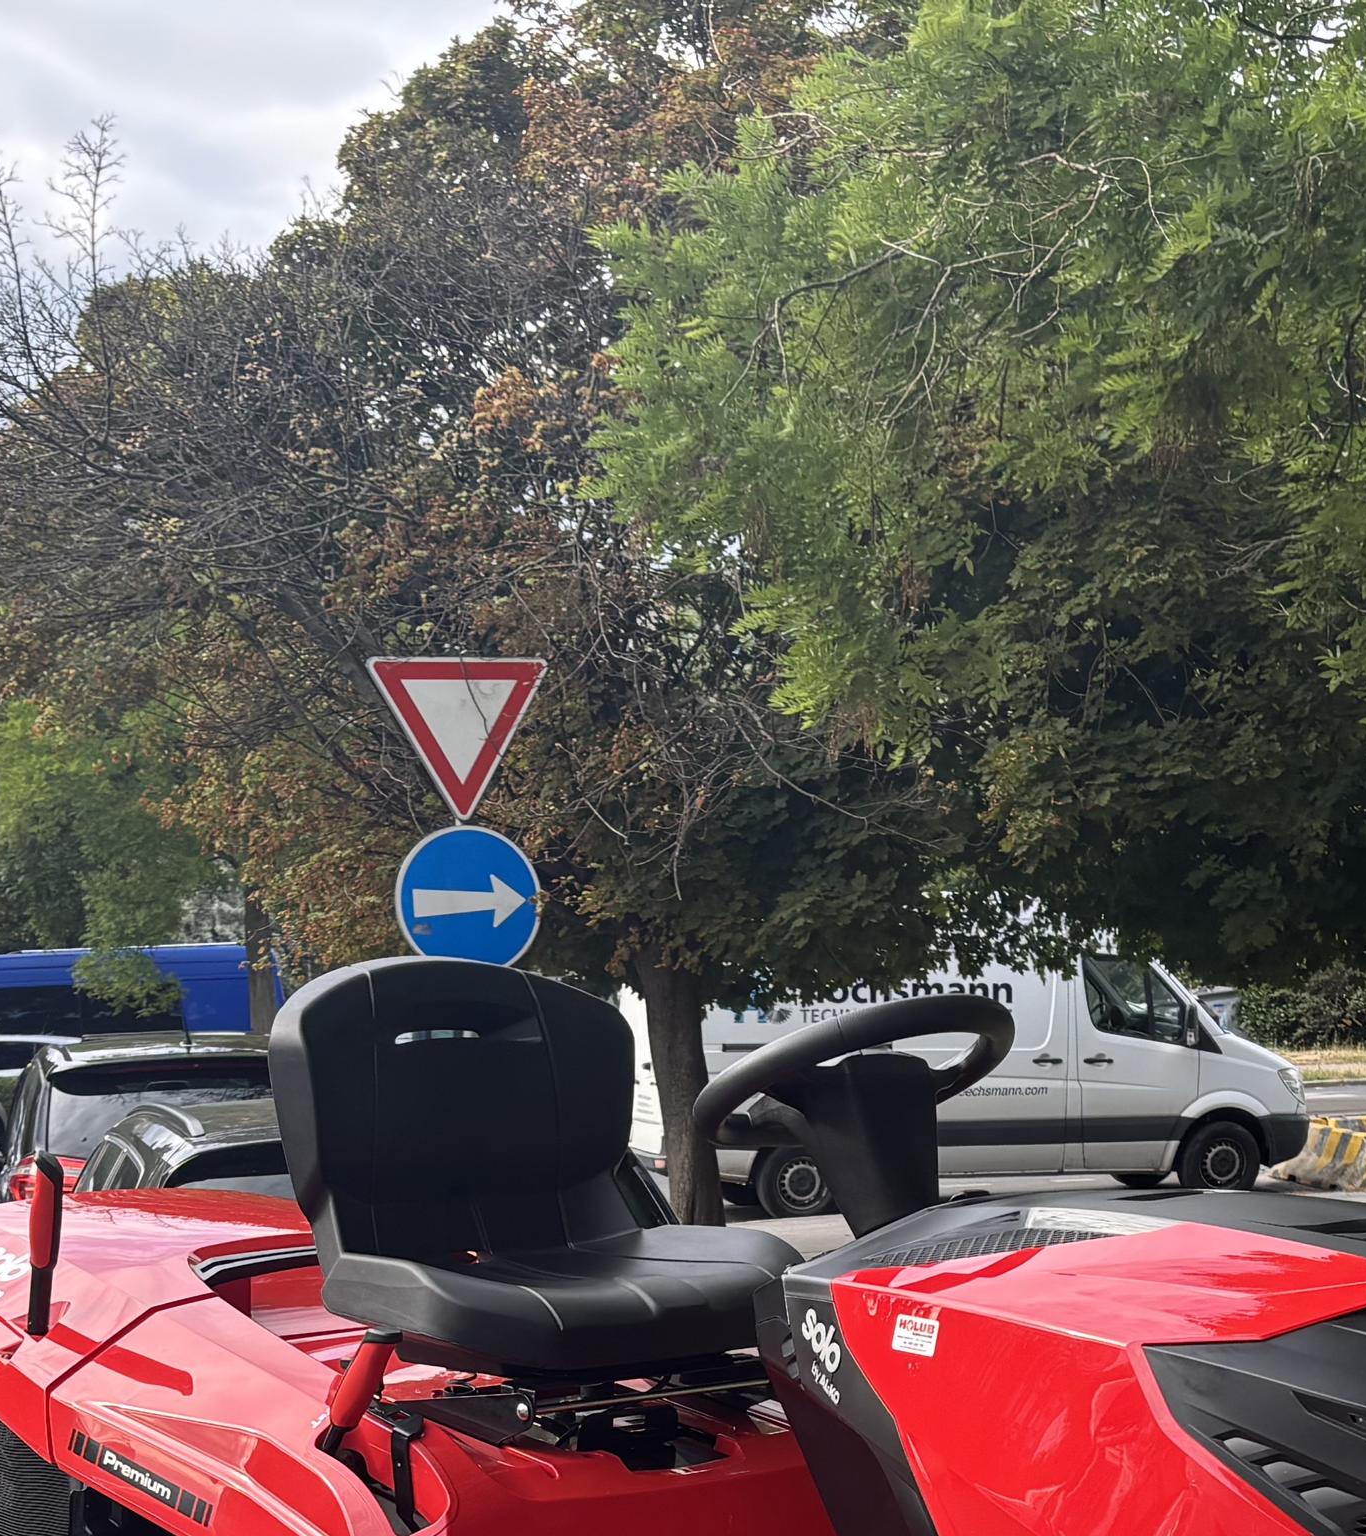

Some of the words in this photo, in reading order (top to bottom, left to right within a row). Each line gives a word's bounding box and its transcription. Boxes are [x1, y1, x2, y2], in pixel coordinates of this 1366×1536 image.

[801, 1308, 841, 1374] solo
[899, 1319, 935, 1335] HOLUB
[102, 1450, 172, 1501] Premium
